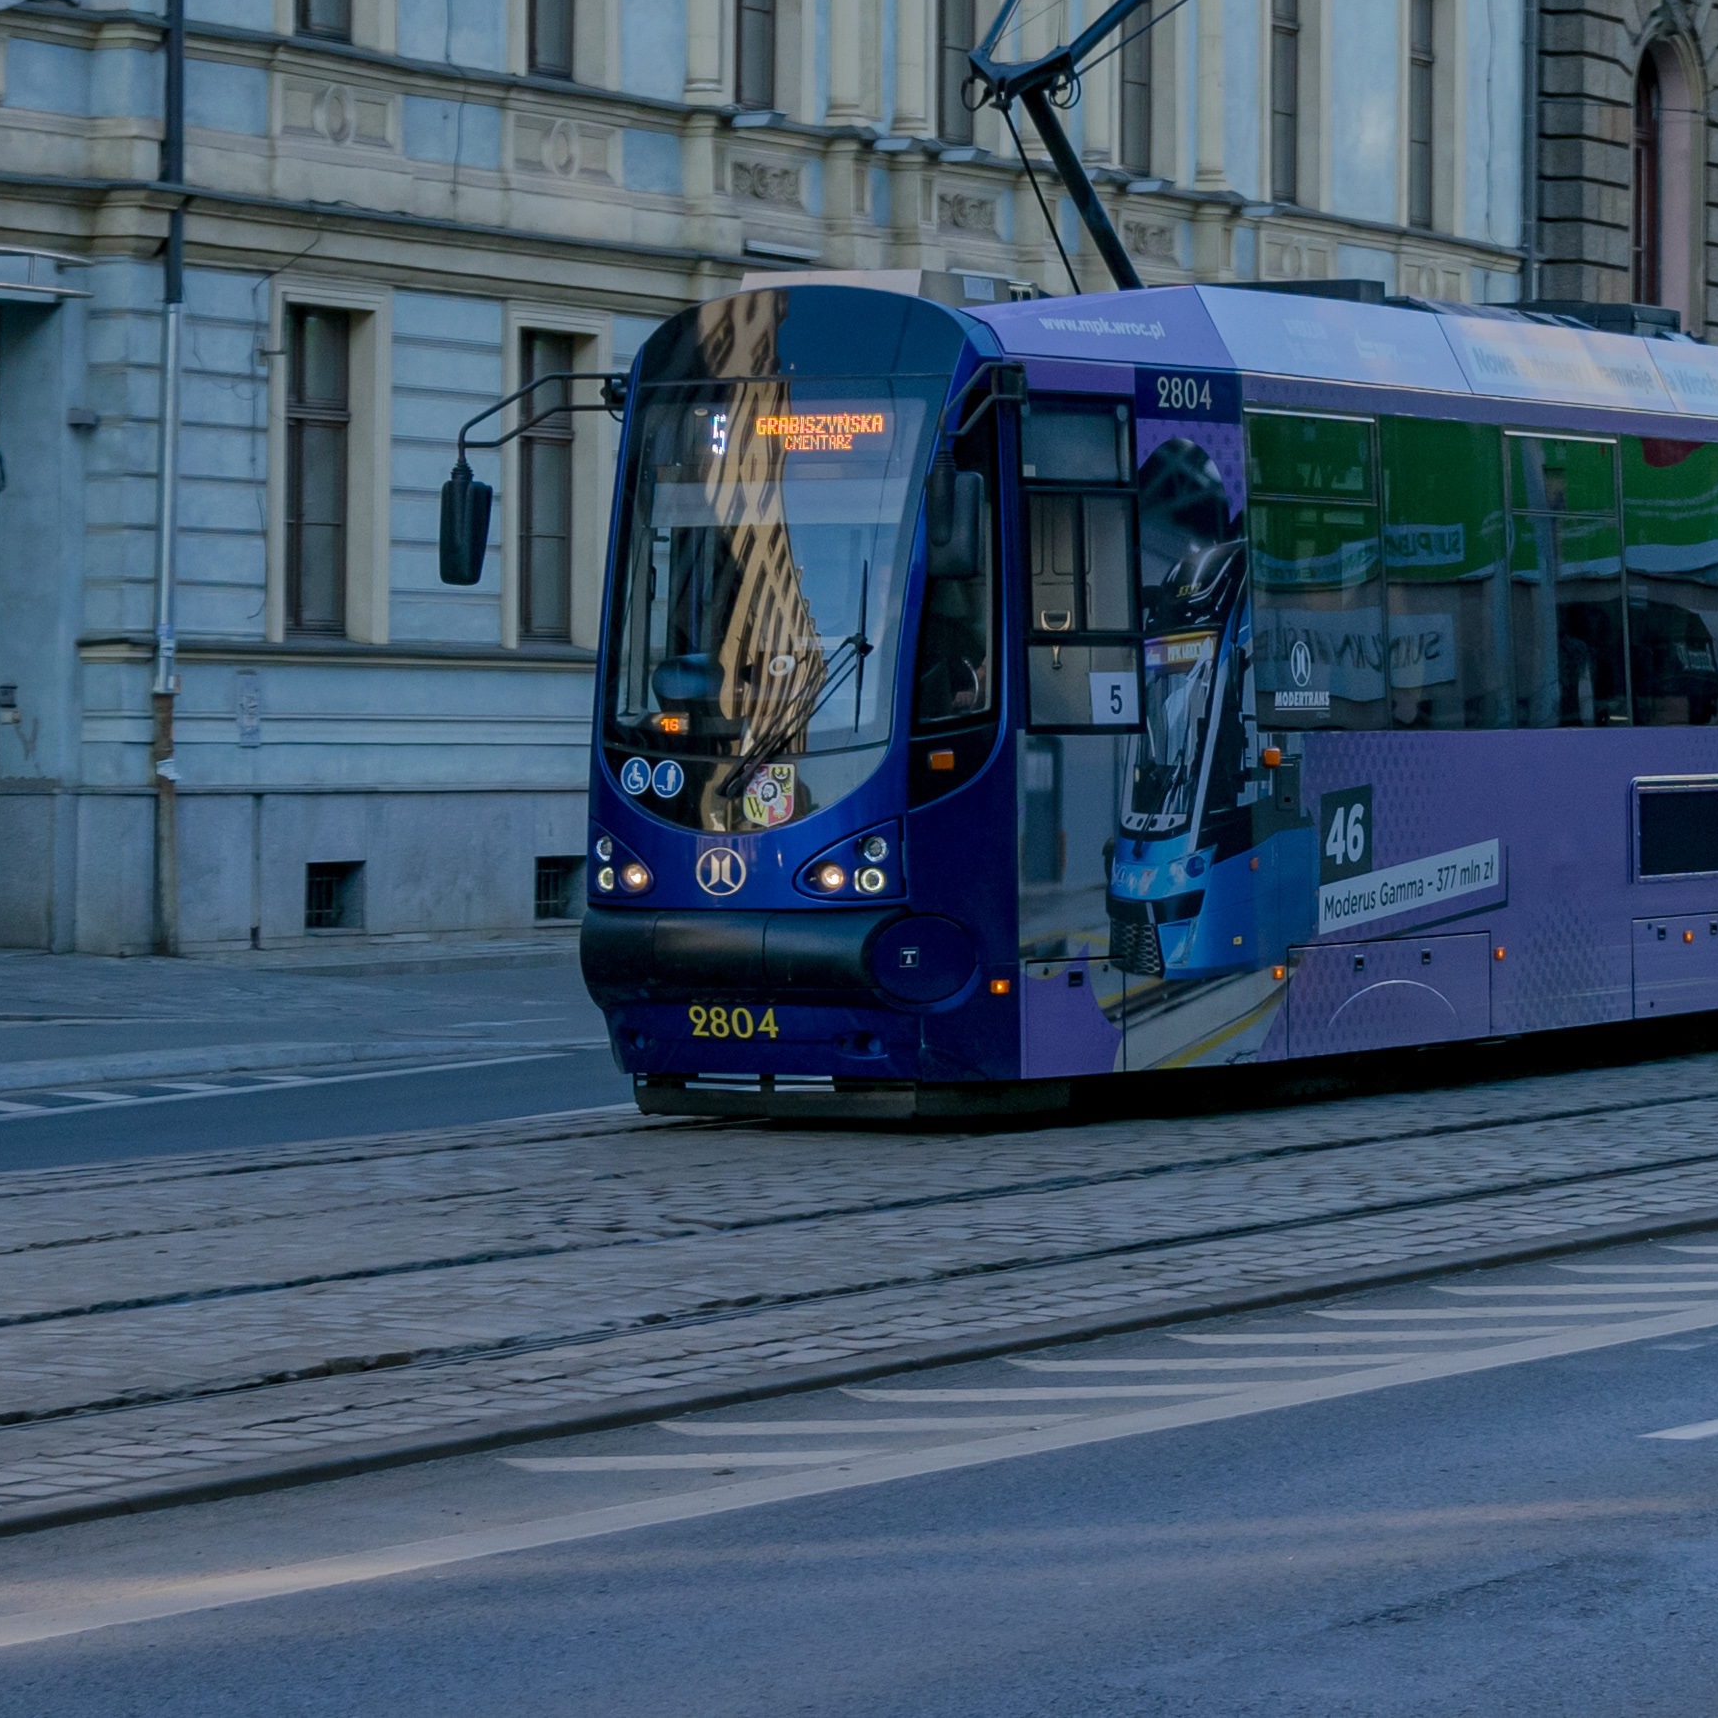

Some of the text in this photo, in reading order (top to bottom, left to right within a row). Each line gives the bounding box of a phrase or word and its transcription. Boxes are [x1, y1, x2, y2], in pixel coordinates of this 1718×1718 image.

[1039, 316, 1166, 339] www.mpk.wroc.pl
[1472, 346, 1518, 377] Nowe
[1157, 375, 1213, 410] 2804
[755, 412, 885, 435] GRABISZYŃSKA
[784, 434, 853, 450] CMENTARZ
[1110, 684, 1123, 715] 5
[1275, 691, 1331, 707] MODERTRANS
[661, 717, 680, 732] 16
[1325, 803, 1365, 865] 46
[1324, 890, 1376, 922] Moderus
[1379, 878, 1424, 907] Gamma
[1436, 864, 1457, 893] 377
[1460, 859, 1480, 887] mln
[1483, 854, 1494, 880] zł
[688, 1004, 780, 1039] 2804
